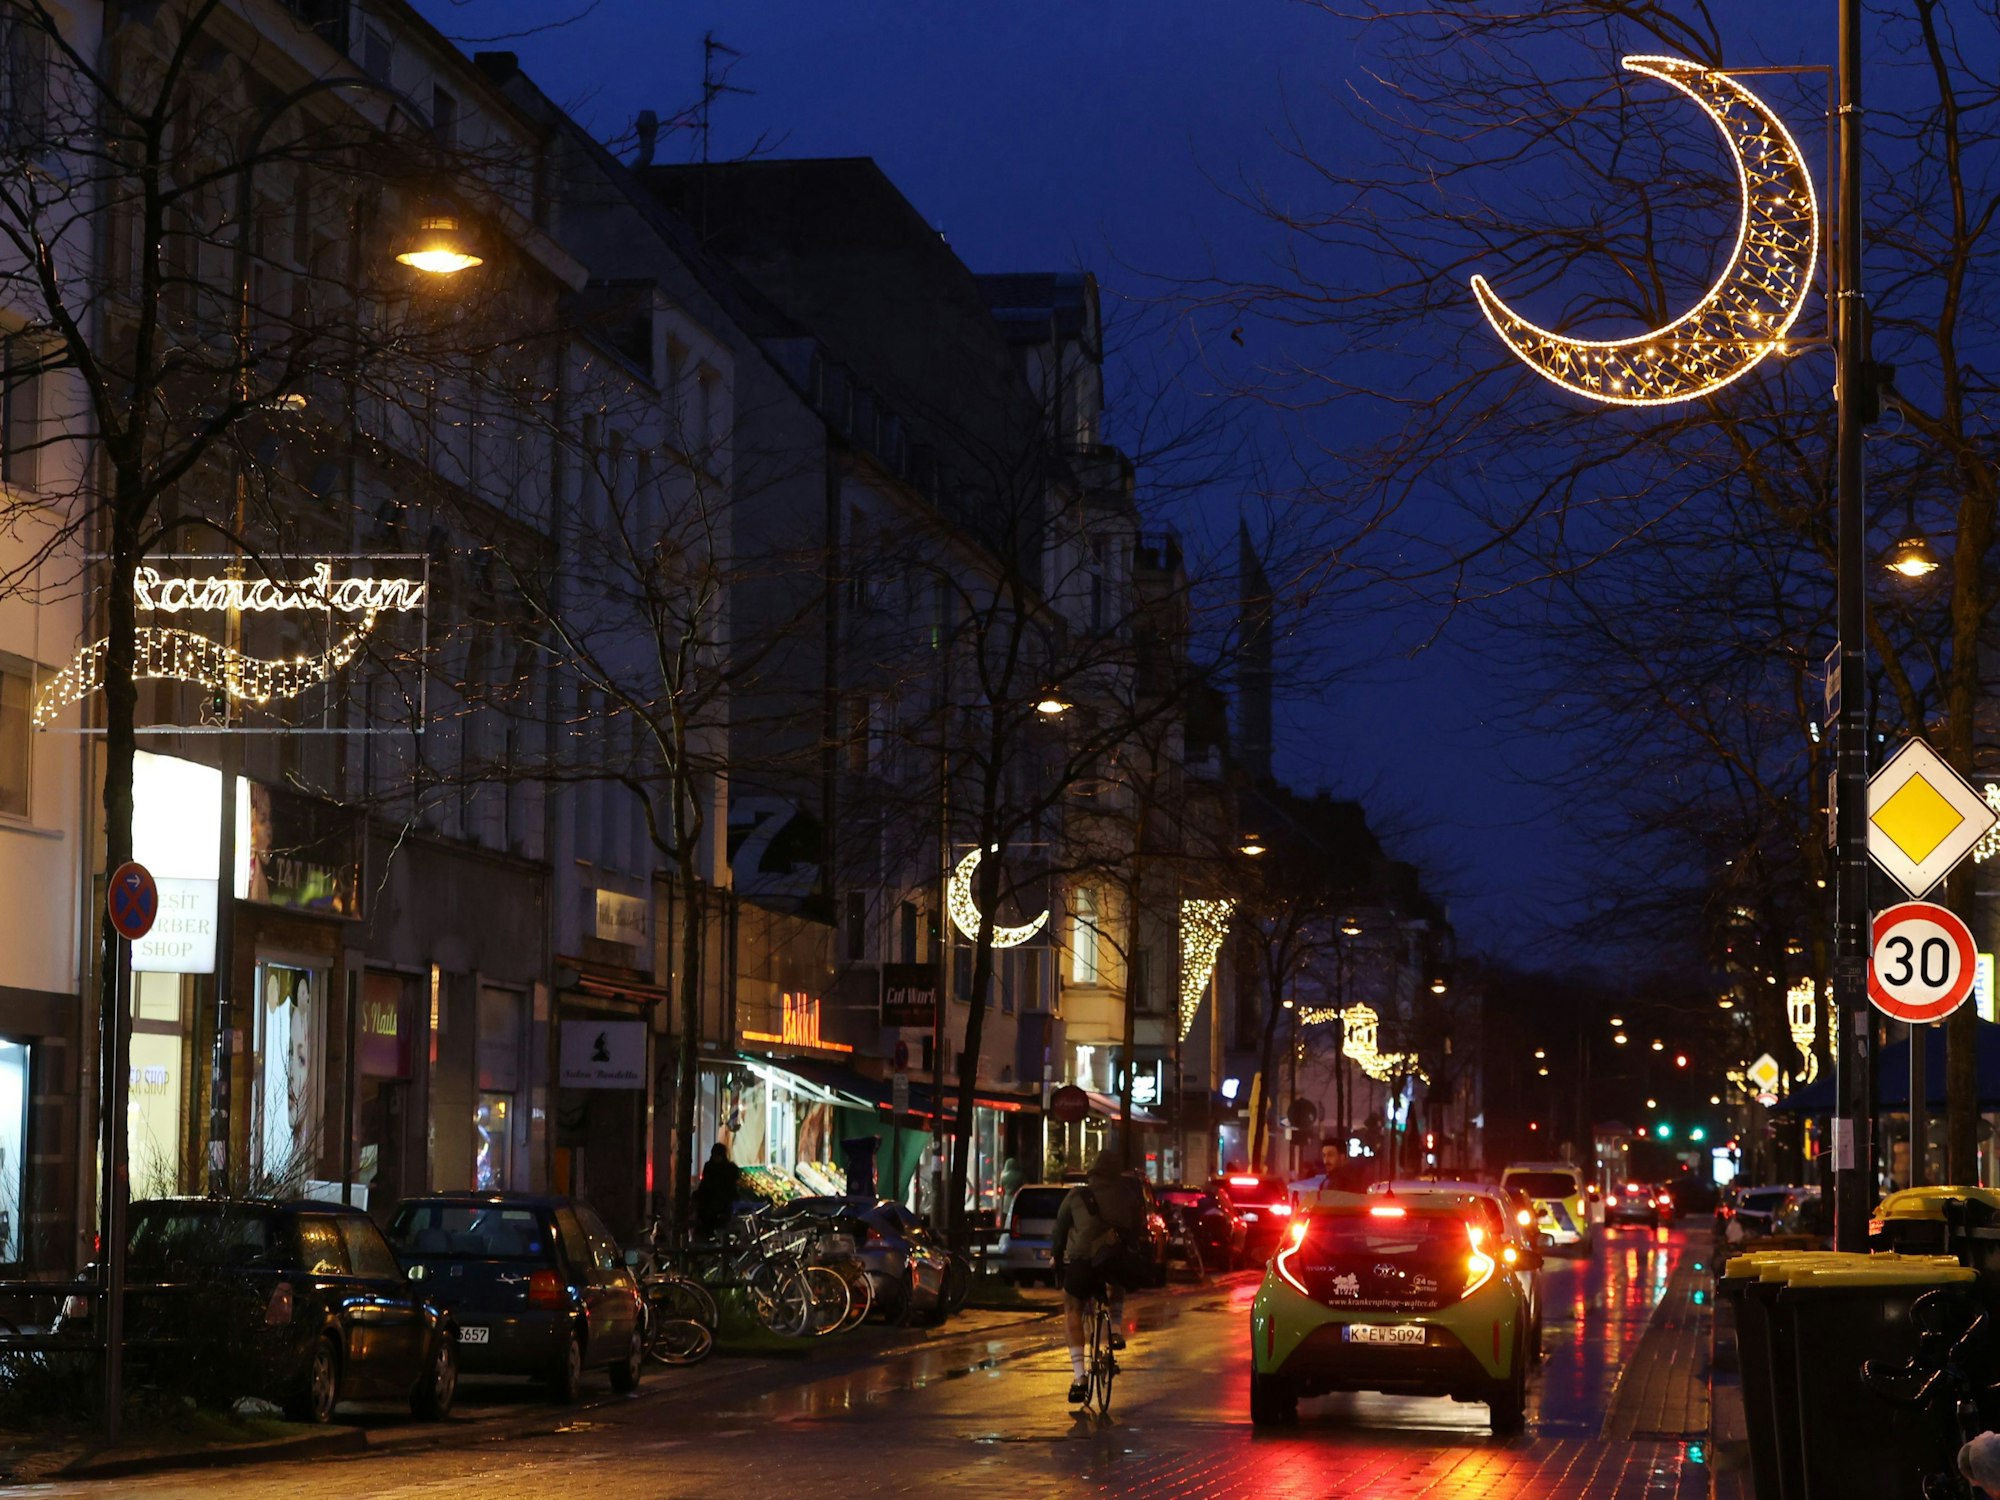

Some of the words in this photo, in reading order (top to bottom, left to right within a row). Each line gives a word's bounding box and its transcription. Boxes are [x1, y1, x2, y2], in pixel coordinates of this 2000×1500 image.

[134, 562, 425, 613] Ramadan
[157, 890, 200, 912] EŞİT
[150, 918, 210, 935] RBER
[142, 941, 193, 957] SHOP
[1884, 936, 1950, 988] 30
[145, 1069, 170, 1096] SHOP
[1351, 1328, 1359, 1341] K
[1389, 1329, 1423, 1342] 5094
